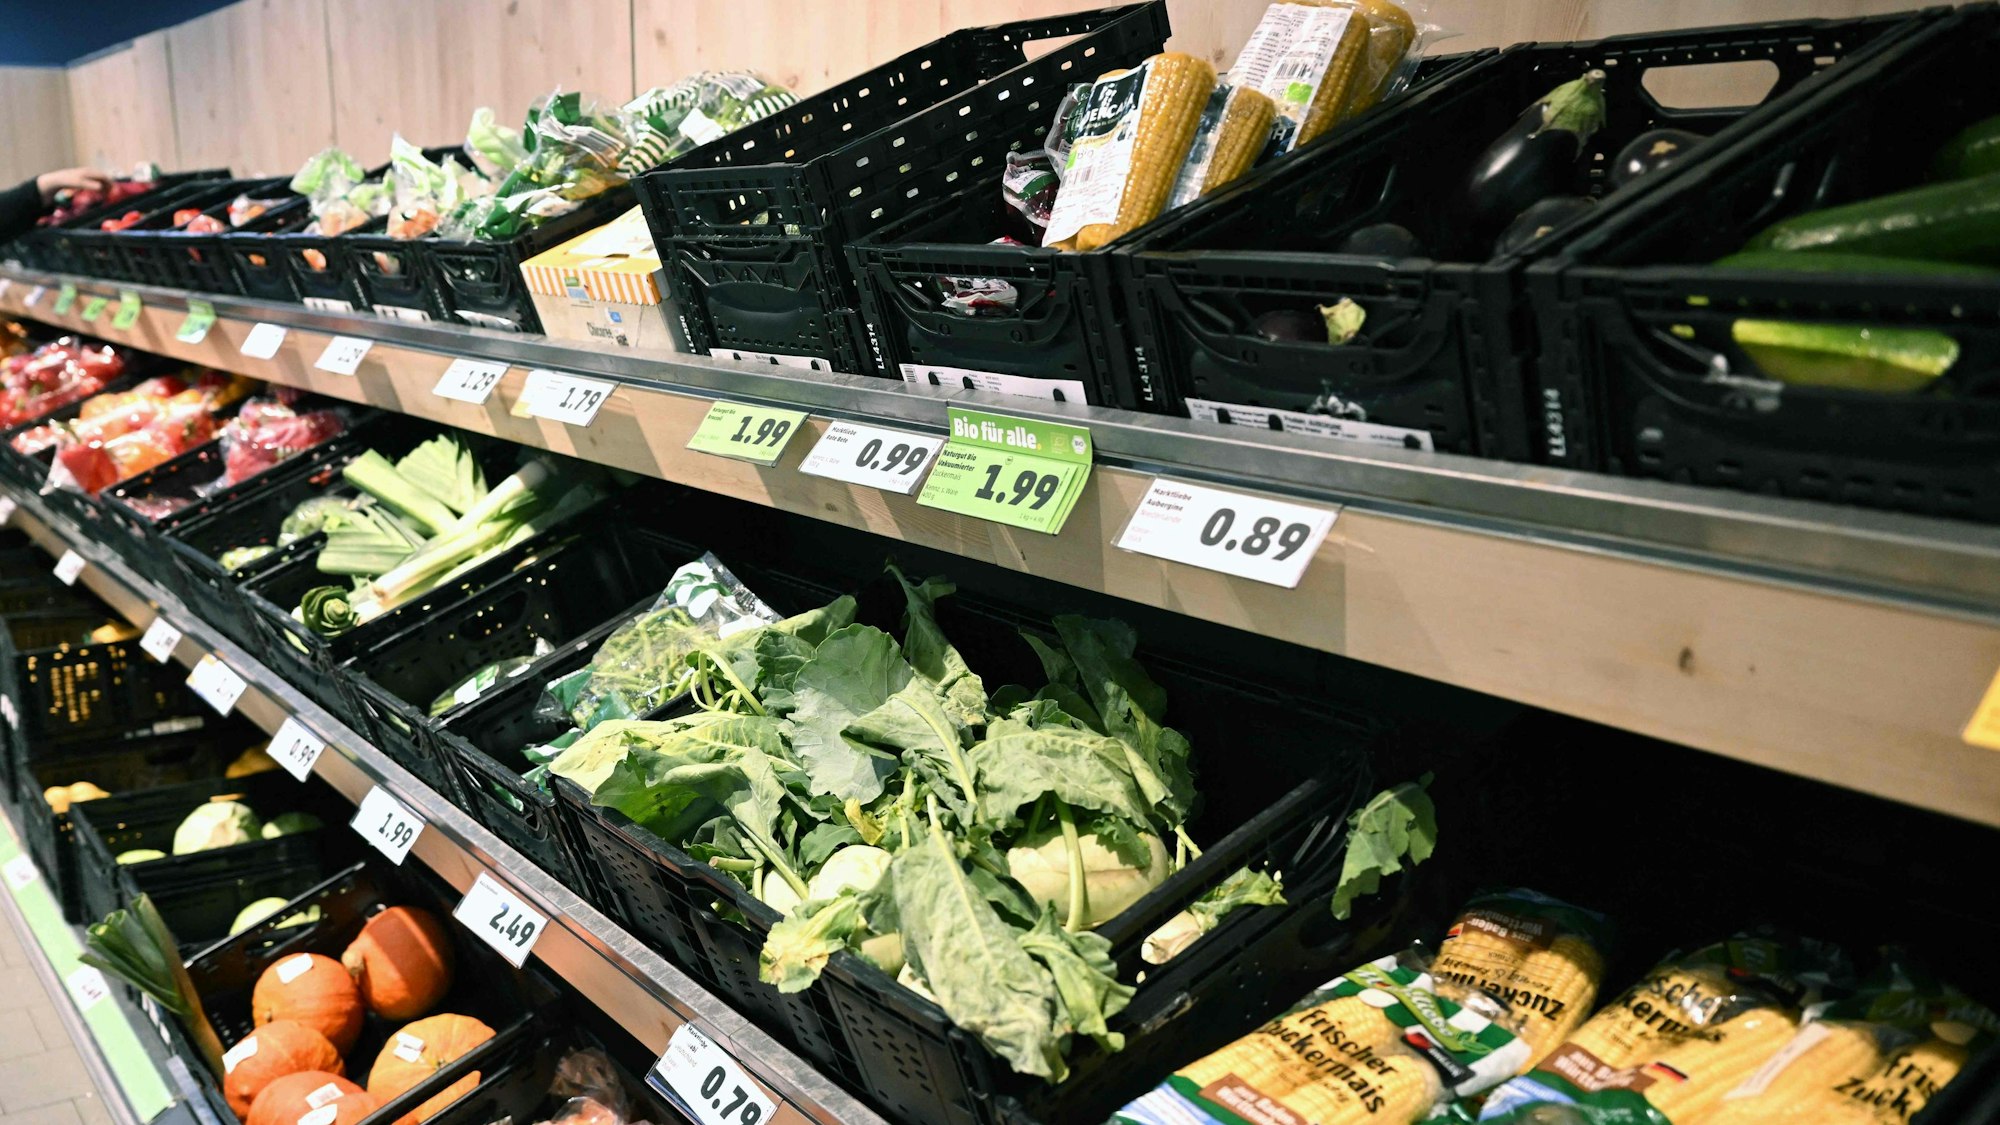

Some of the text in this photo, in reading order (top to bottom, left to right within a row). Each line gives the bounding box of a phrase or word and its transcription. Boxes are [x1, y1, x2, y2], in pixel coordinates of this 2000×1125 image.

[866, 322, 885, 370] LL4314
[460, 370, 496, 392] 1.29
[1134, 346, 1154, 402] LL4314
[559, 387, 602, 413] 1.79
[730, 416, 791, 448] 1.99
[832, 426, 857, 436] Marktliebe
[953, 416, 1042, 451] Bio für alle.
[1543, 388, 1567, 457] LL4314
[855, 438, 928, 476] 0.99
[937, 459, 975, 472] Vakuumierter
[943, 449, 977, 461] Naturgut Bio
[932, 468, 962, 481] Zuckermais
[945, 488, 958, 496] Ware
[975, 464, 1059, 511] 1.99
[1146, 498, 1184, 512] Aubergine
[1153, 487, 1192, 501] Marktliebe
[1200, 508, 1311, 561] 0.89
[289, 738, 315, 768] 0.99
[378, 812, 413, 849] 1.99
[489, 902, 536, 948] 2.49
[1298, 1009, 1399, 1075] Frischer
[1884, 1052, 1942, 1098] Fris
[700, 1065, 762, 1125] 0.79
[1832, 1075, 1910, 1118] Zuck
